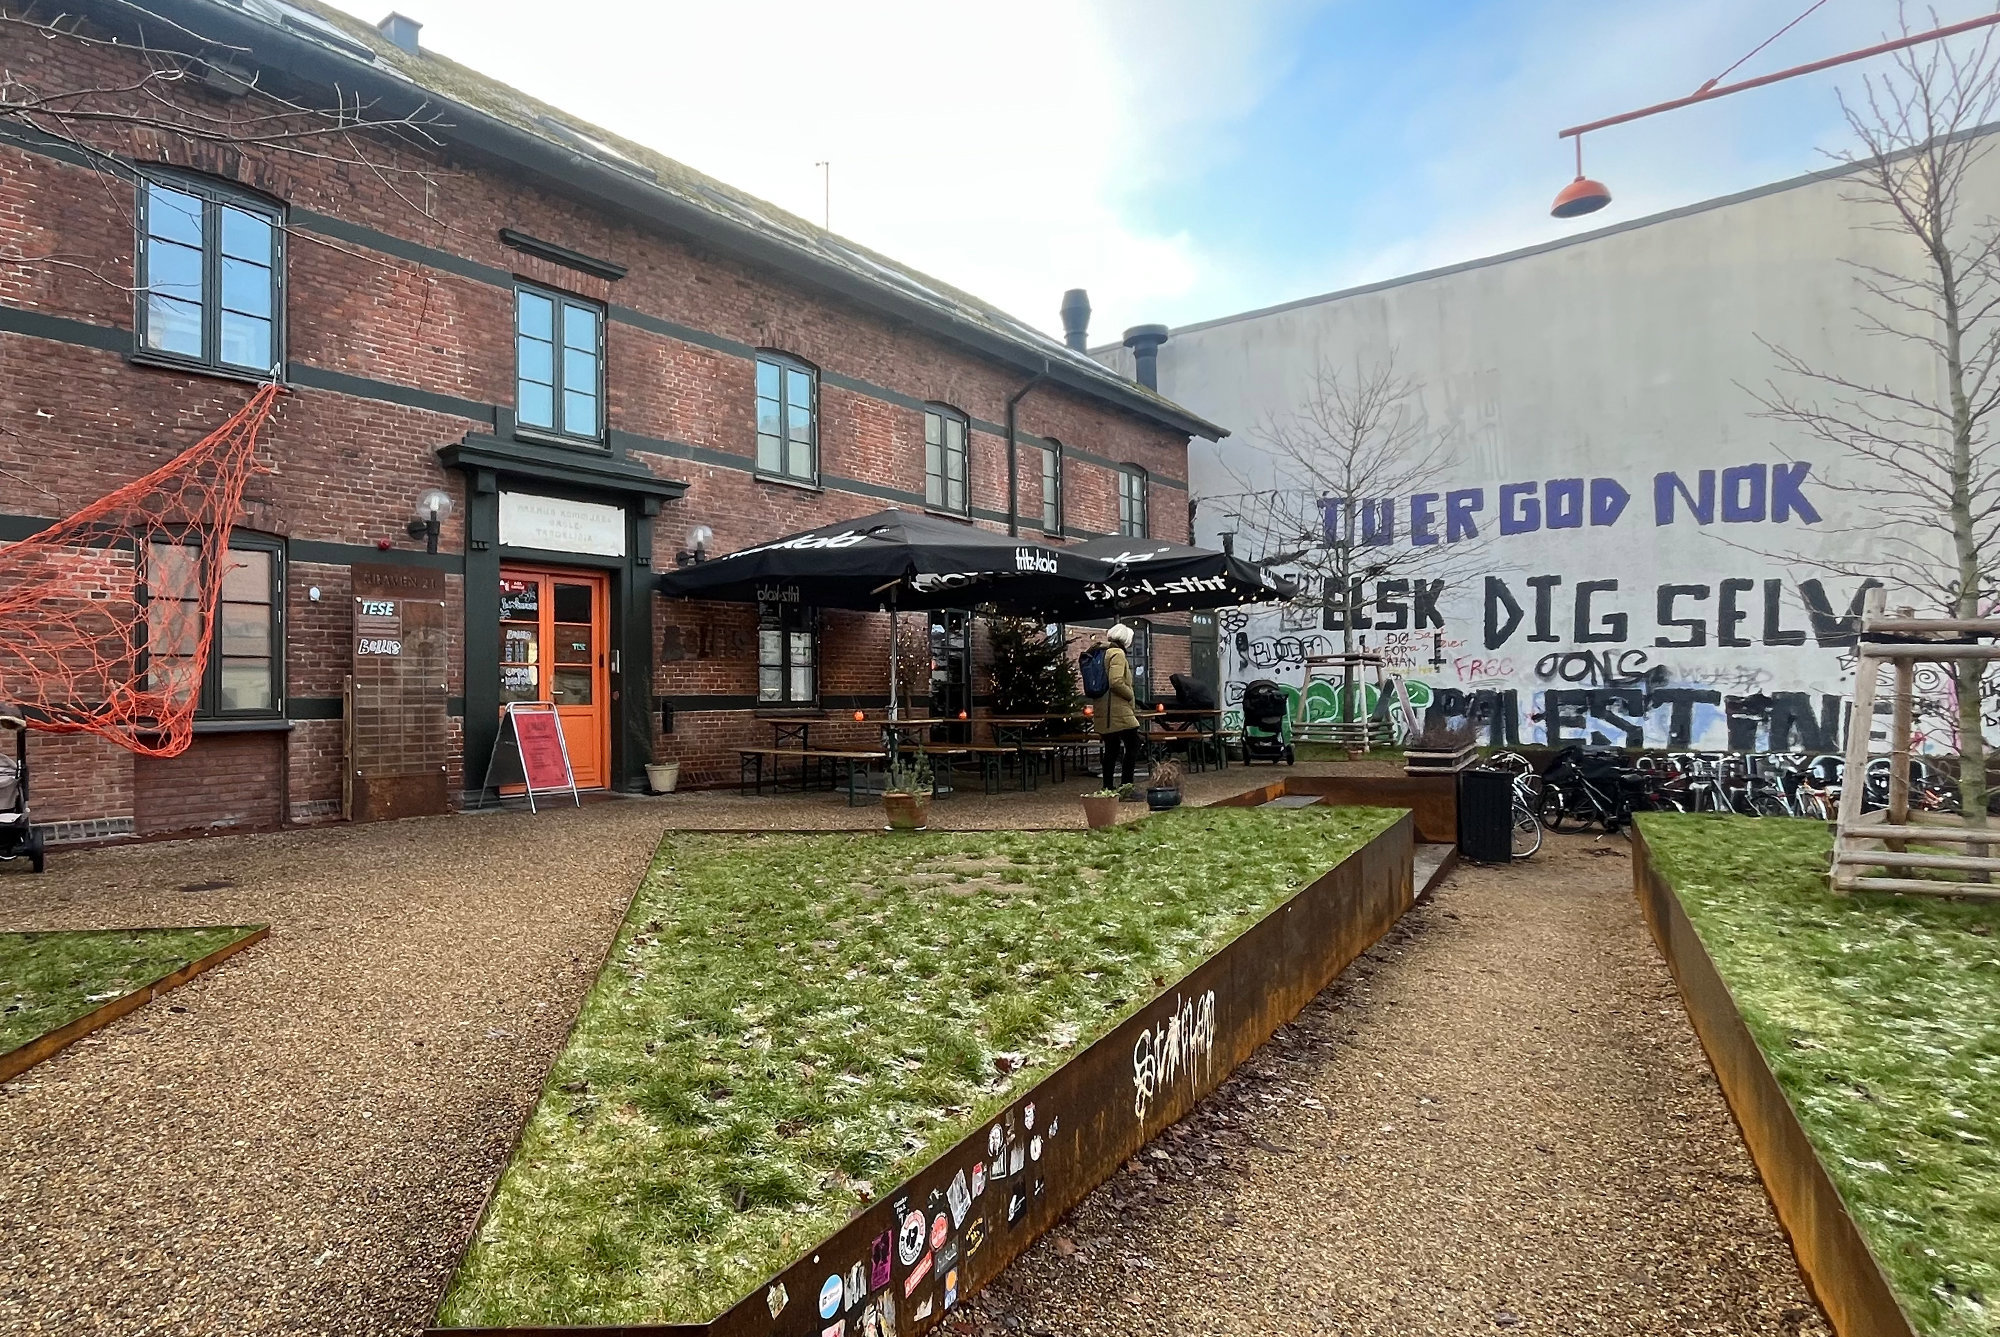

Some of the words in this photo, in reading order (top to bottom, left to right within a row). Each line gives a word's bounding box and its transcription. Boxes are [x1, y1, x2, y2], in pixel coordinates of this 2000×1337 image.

[1411, 488, 1484, 546] ER
[1500, 478, 1631, 536] GOD
[1654, 461, 1822, 526] NOK
[1016, 547, 1058, 574] fritz-kola
[363, 572, 418, 588] GRAVEN
[362, 601, 395, 616] TESE
[1485, 575, 1628, 650] DIG
[1654, 578, 1884, 648] SELV
